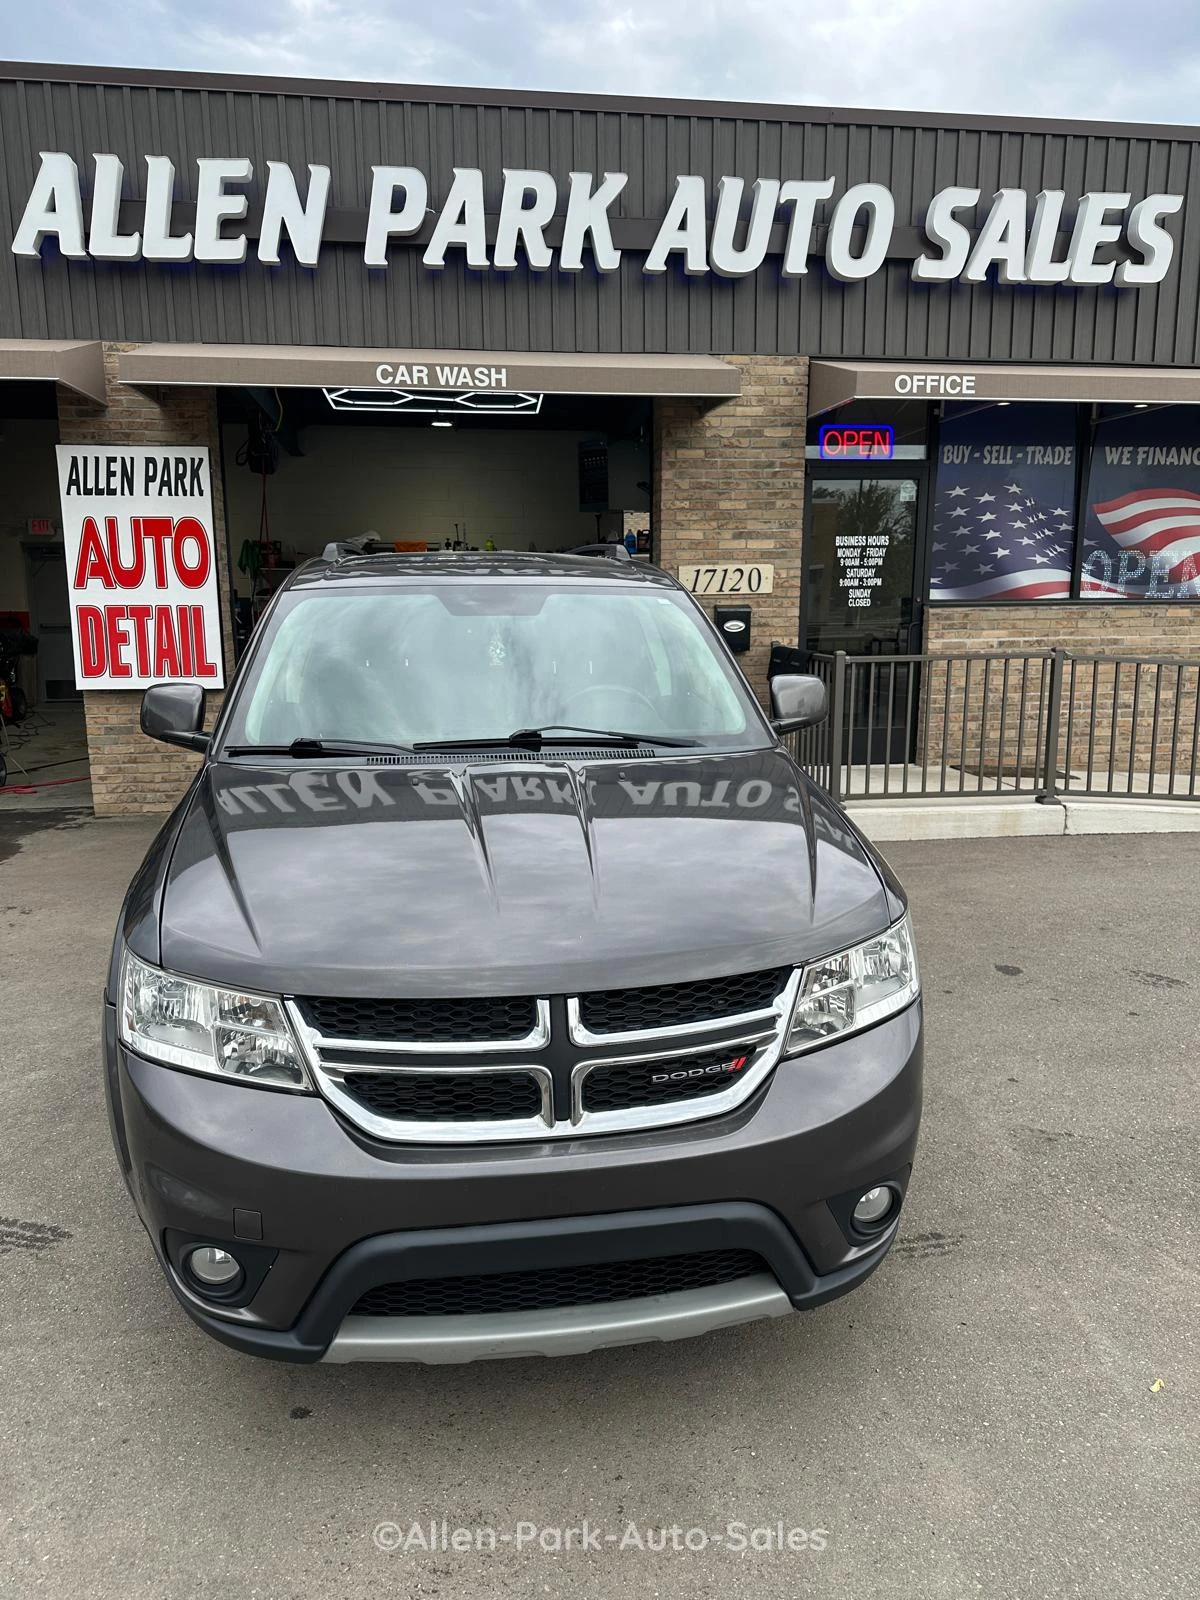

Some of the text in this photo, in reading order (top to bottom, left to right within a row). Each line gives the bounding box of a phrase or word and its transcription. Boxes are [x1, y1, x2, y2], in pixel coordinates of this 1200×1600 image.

[12, 151, 1184, 288] ALLEN PARK AUTO SALES
[375, 363, 508, 388] CAR WASH
[894, 374, 976, 395] OFFICE
[823, 430, 890, 456] OPEN
[943, 445, 974, 465] BUY
[983, 445, 1013, 465] SELL
[1026, 445, 1073, 466] TRADE
[1105, 446, 1133, 466] WE
[66, 455, 204, 497] ALLEN PARK
[835, 535, 890, 546] BUSINESS HOURS
[74, 516, 211, 589] AUTO
[837, 547, 861, 558] MONDAY
[866, 547, 887, 557] FRIDAY
[691, 567, 762, 593] 17120
[846, 568, 876, 578] SATURDAY
[848, 588, 872, 598] SUNDAY
[848, 598, 871, 607] CLOSED
[76, 604, 217, 678] DETAIL
[652, 1060, 737, 1083] DODGE
